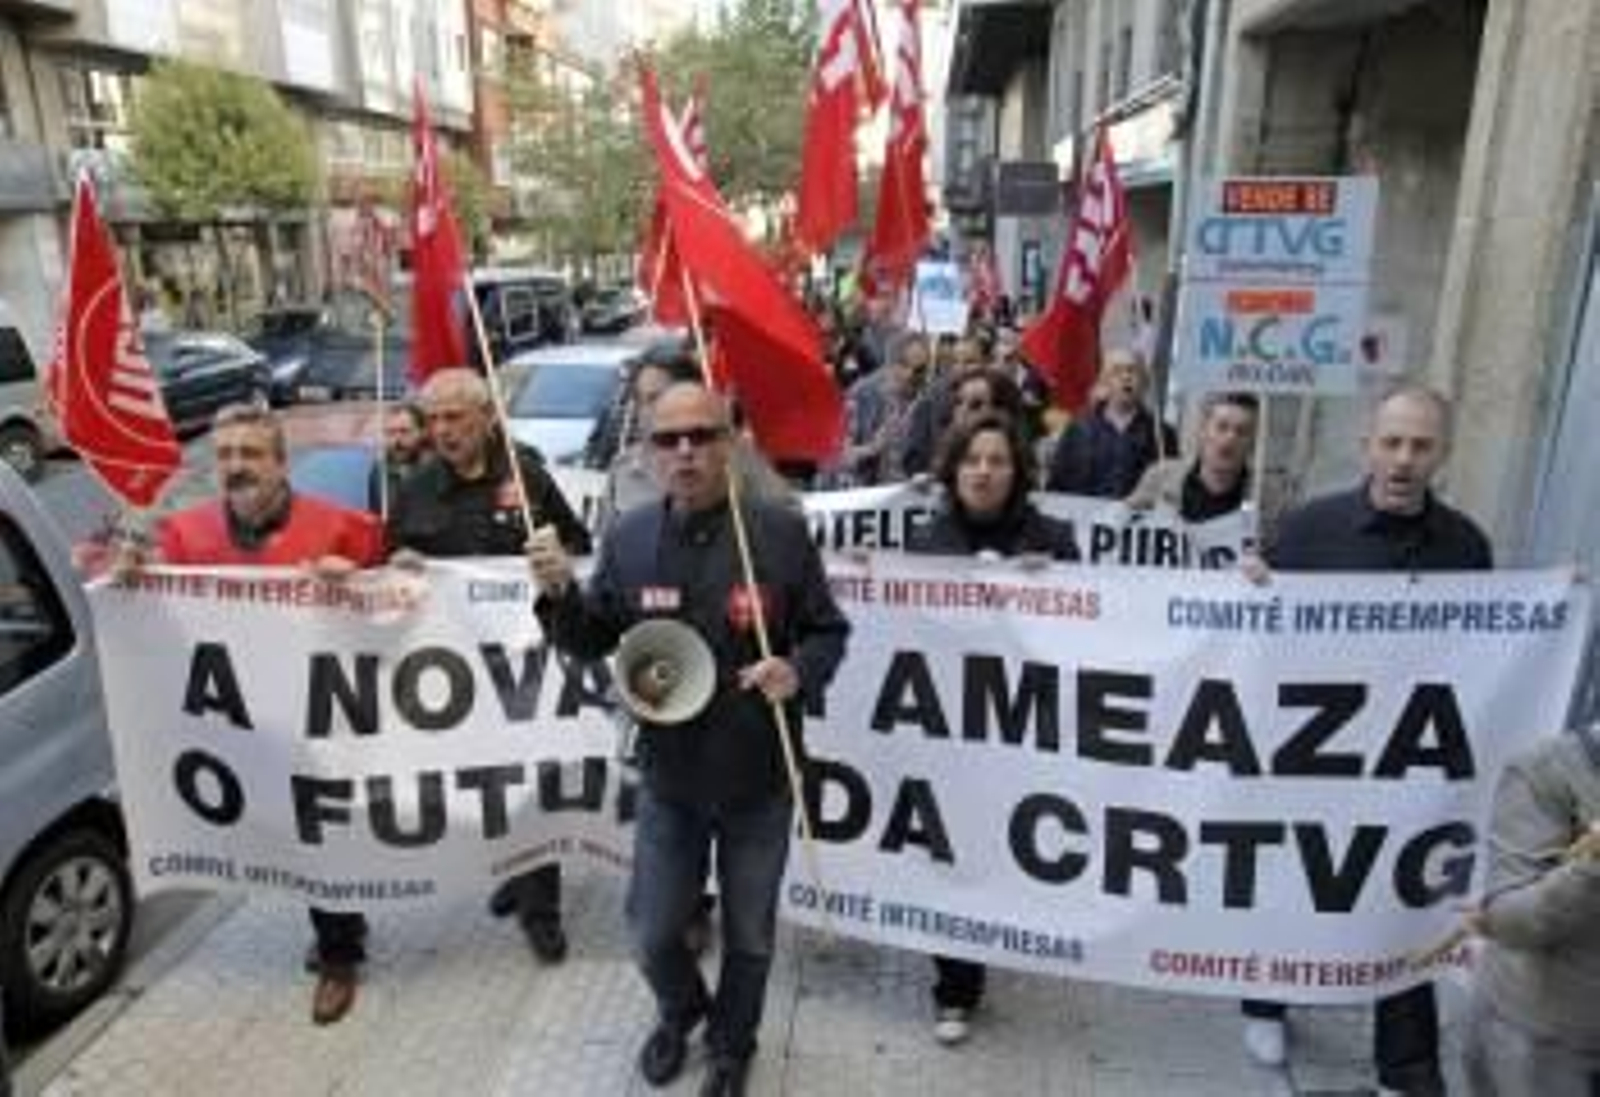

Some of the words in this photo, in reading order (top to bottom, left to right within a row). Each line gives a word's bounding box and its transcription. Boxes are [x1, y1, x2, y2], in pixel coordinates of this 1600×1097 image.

[884, 577, 1101, 619] INTEREMPRESAS
[1168, 596, 1282, 632] COMITÉ
[1294, 600, 1568, 633] INTEREMPRESAS
[182, 642, 253, 730] A
[869, 649, 1476, 781] AMEAZA
[173, 749, 246, 826] O
[798, 755, 956, 868] DA
[1007, 791, 1477, 914] CRTVG
